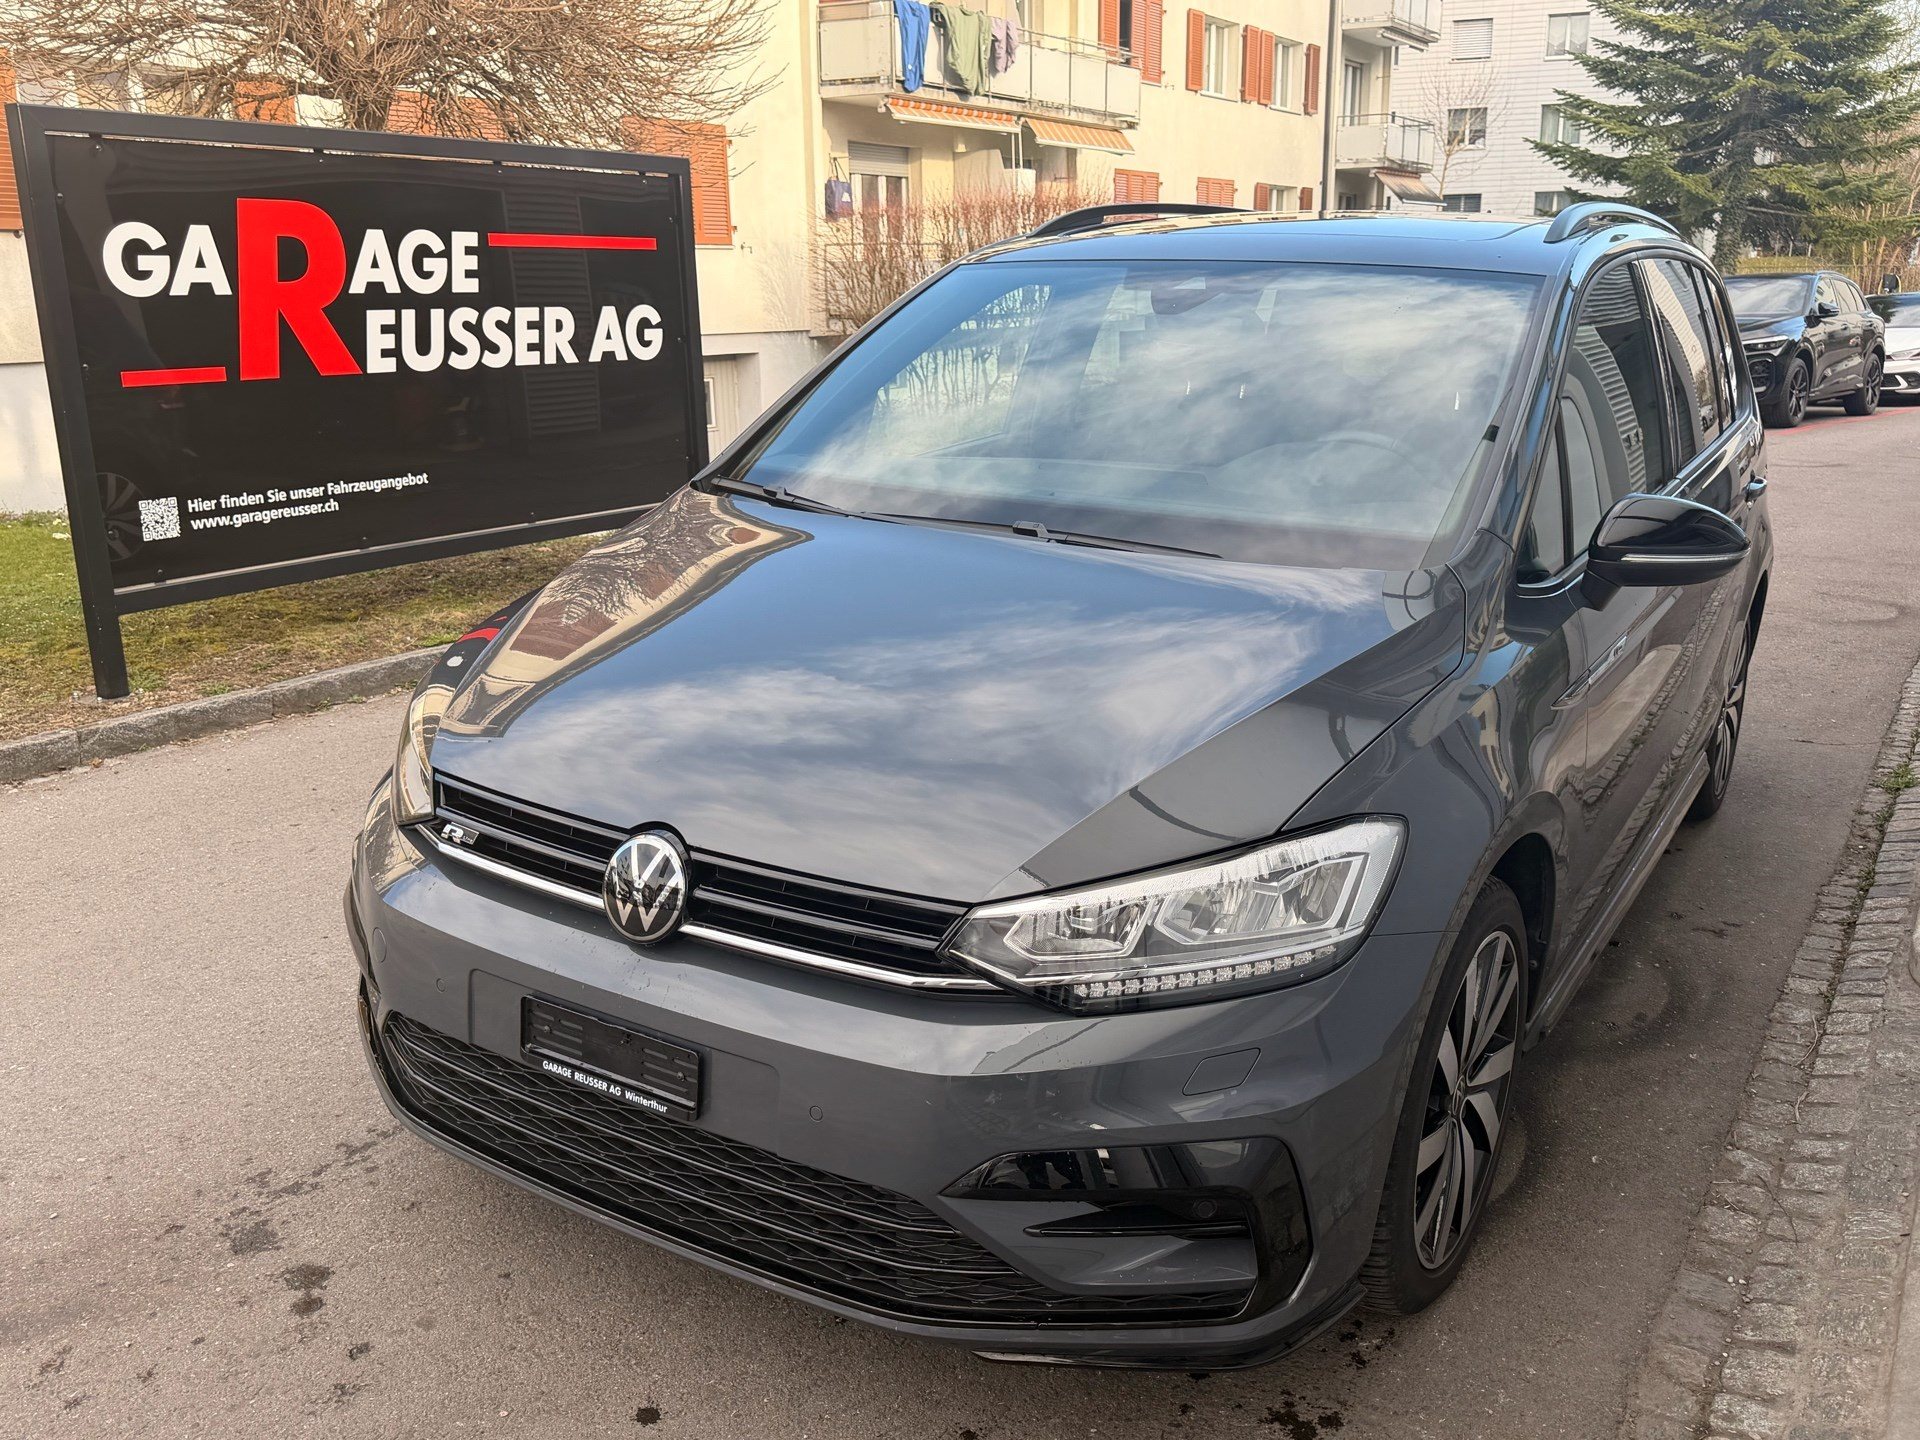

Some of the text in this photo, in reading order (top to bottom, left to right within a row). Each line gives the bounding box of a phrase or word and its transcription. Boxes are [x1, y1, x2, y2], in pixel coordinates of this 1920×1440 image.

[103, 198, 480, 380] GARAGE
[588, 304, 664, 362] AG
[187, 472, 429, 513] Hier finden Sie unser Fahrzeugangebot
[190, 498, 340, 530] www.garagereusser.ch
[542, 1060, 668, 1113] GARAGE REUSSER AG Winterthur
